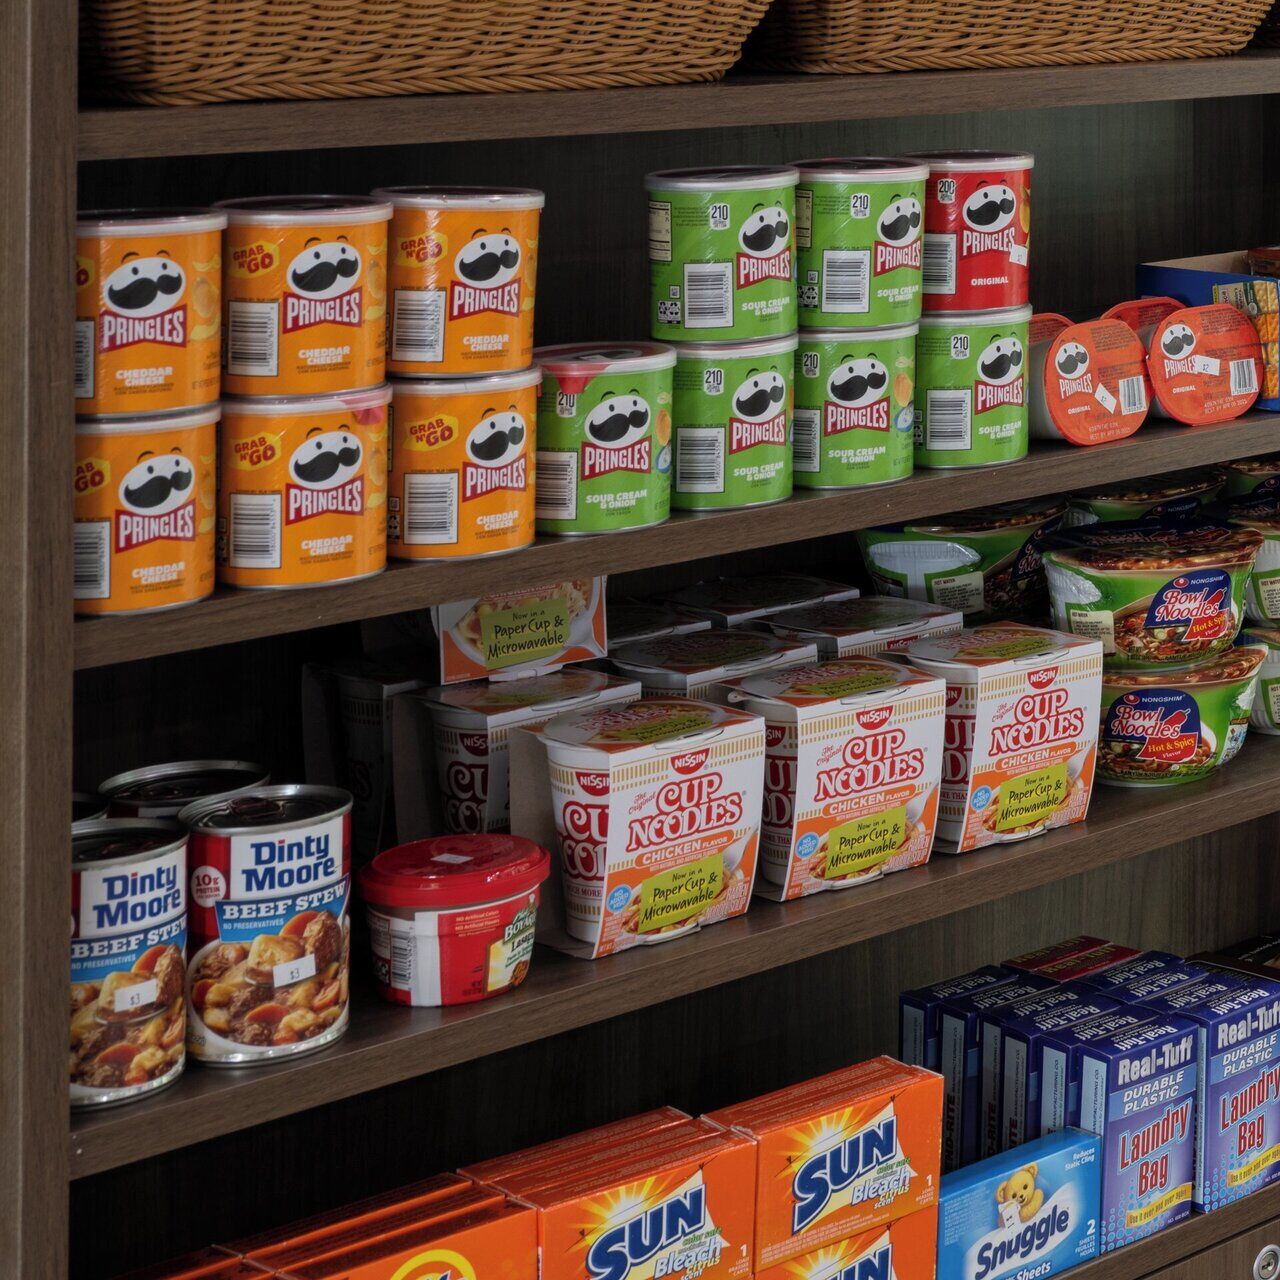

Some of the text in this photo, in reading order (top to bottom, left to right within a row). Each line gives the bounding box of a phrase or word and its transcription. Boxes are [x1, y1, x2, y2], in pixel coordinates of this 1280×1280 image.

[852, 195, 869, 210] 210
[962, 229, 1015, 255] PRINGLES
[970, 276, 1009, 286] ORIGINAL
[102, 313, 186, 348] PRINGLES
[116, 366, 173, 380] CHEDDAR
[125, 375, 164, 386] CHEESE
[1203, 364, 1209, 372] $2
[1059, 374, 1093, 400] PRINGLES
[1172, 386, 1196, 394] ORIGINAL
[828, 446, 886, 460] SOUR CREAM
[847, 453, 874, 464] ONION
[289, 482, 363, 520] PRINGLES
[1164, 587, 1208, 607] Bowl
[1155, 602, 1220, 622] Noodles
[1142, 695, 1184, 703] NONGSHIM
[859, 709, 889, 724] NISSIN
[1117, 706, 1163, 721] Bowl
[1111, 718, 1180, 738] Noodles
[843, 729, 905, 766] CUP
[1148, 736, 1196, 753] Hot & Spicy
[1162, 750, 1181, 759] Flavor
[674, 752, 705, 768] NISSIN
[814, 748, 924, 801] NOODLES
[656, 772, 722, 816] CUP
[626, 792, 743, 852] NOODLES
[250, 834, 329, 866] Dinty
[642, 836, 728, 864] CHICKEN FLAVOR
[103, 865, 177, 900] Dinty
[242, 856, 335, 892] Moore
[653, 872, 717, 902] Paper Cup &
[672, 873, 686, 882] Now
[688, 870, 696, 878] in
[93, 888, 181, 928] Moore
[222, 881, 345, 920] BEEF STEW
[642, 889, 714, 924] Microwavable
[233, 919, 284, 929] PRESERVATIVES
[131, 993, 140, 1005] $3
[1117, 1034, 1193, 1086] Real-Tuff
[1124, 1070, 1184, 1103] DURABLE
[1124, 1086, 1179, 1114] PLASTIC
[1120, 1103, 1189, 1170] Laundry
[1073, 1148, 1095, 1160] Reduces
[1081, 1155, 1095, 1167] Cling
[792, 1114, 898, 1236] SUN
[852, 1167, 910, 1206] Bleach
[1138, 1152, 1169, 1198] Bag
[586, 1183, 706, 1280] SUN
[975, 1205, 1070, 1280] Snuggle
